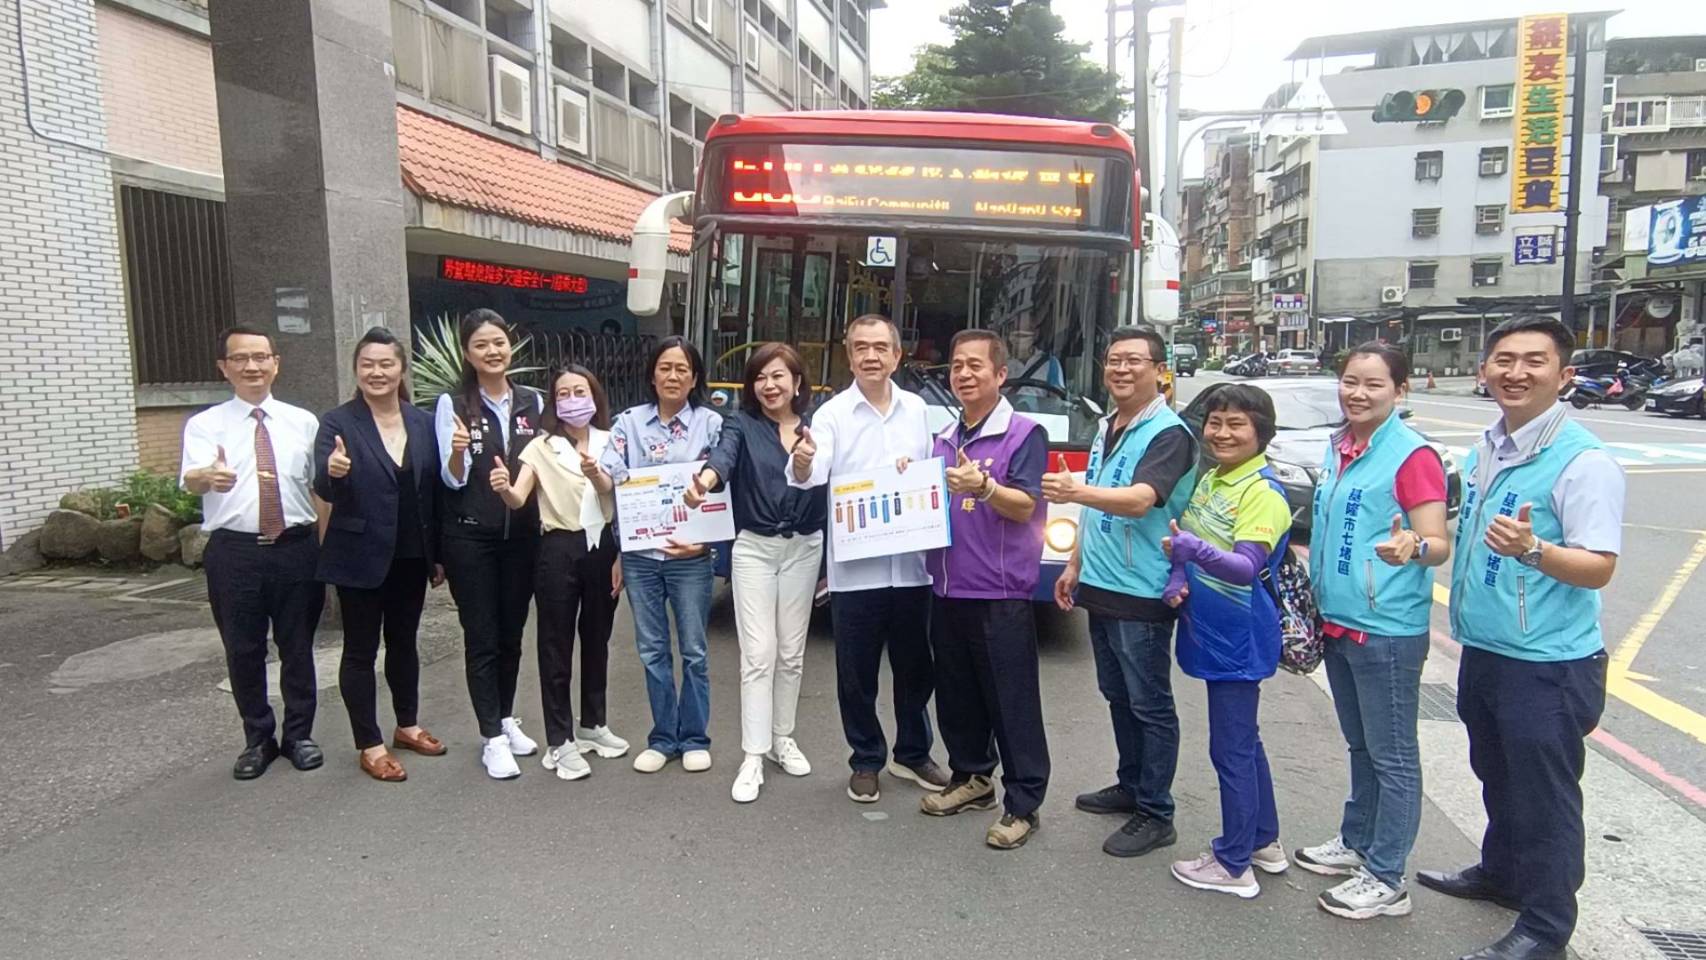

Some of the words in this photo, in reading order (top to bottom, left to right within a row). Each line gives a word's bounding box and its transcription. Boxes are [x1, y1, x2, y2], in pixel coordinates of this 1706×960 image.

[470, 420, 484, 454] 怡芳
[1100, 456, 1128, 533] 基隆堵區
[1337, 488, 1363, 576] 基隆市七堵區
[1483, 491, 1519, 588] 基隆堵區
